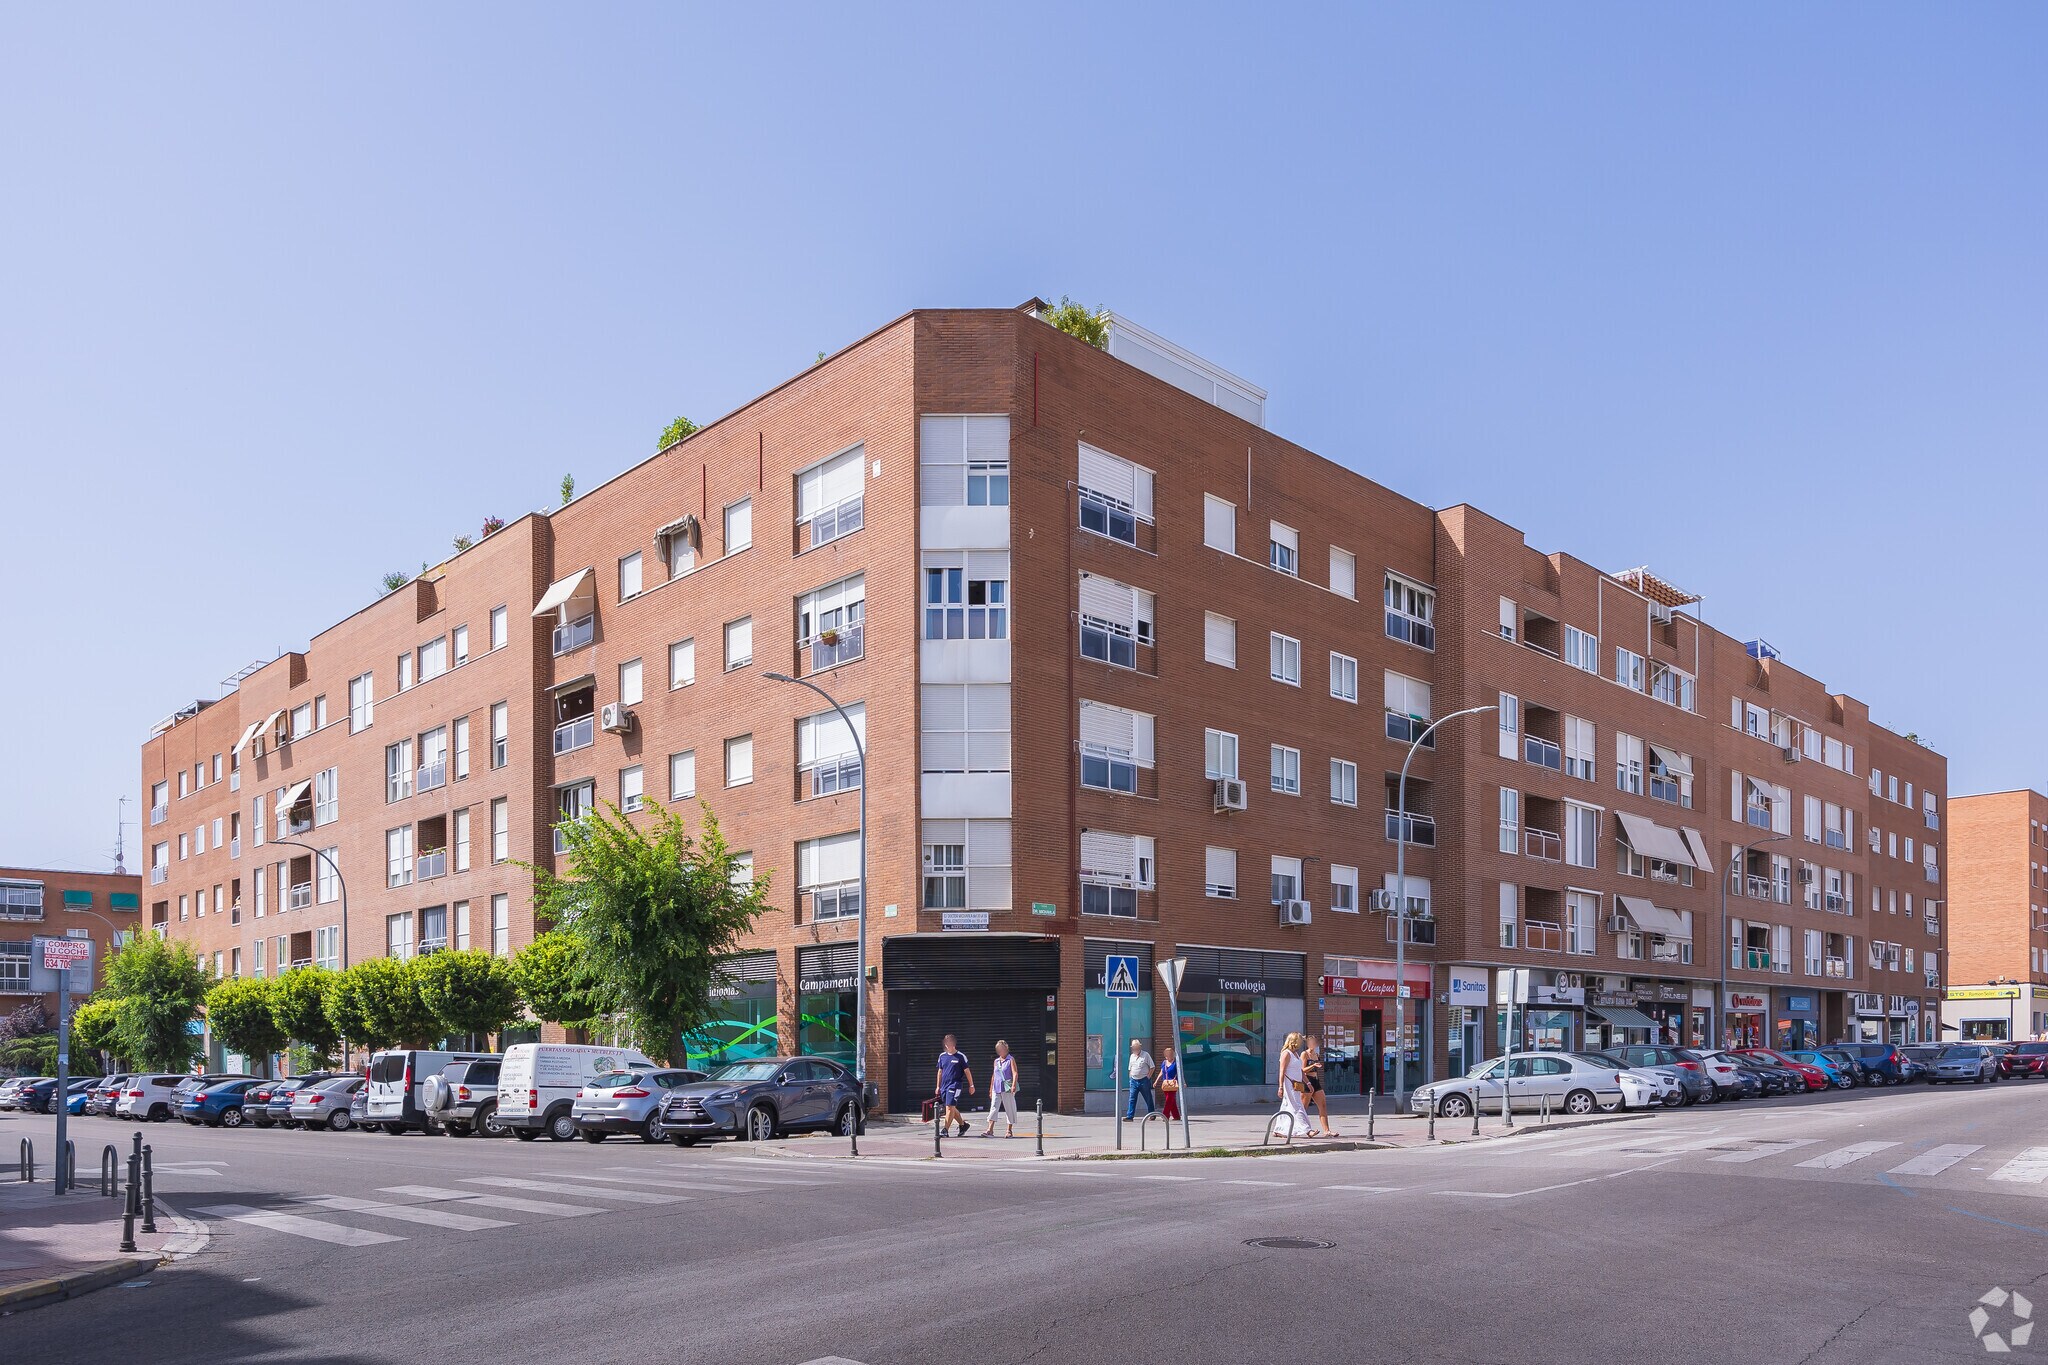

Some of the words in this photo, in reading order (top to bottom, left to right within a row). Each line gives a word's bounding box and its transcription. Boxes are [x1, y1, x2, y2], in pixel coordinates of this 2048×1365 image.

[48, 941, 86, 949] COMPRO
[45, 946, 56, 954] TU
[58, 948, 88, 956] COCHE
[45, 958, 58, 968] 634
[1361, 979, 1396, 996] Olimpus
[1462, 981, 1486, 992] Sanitas
